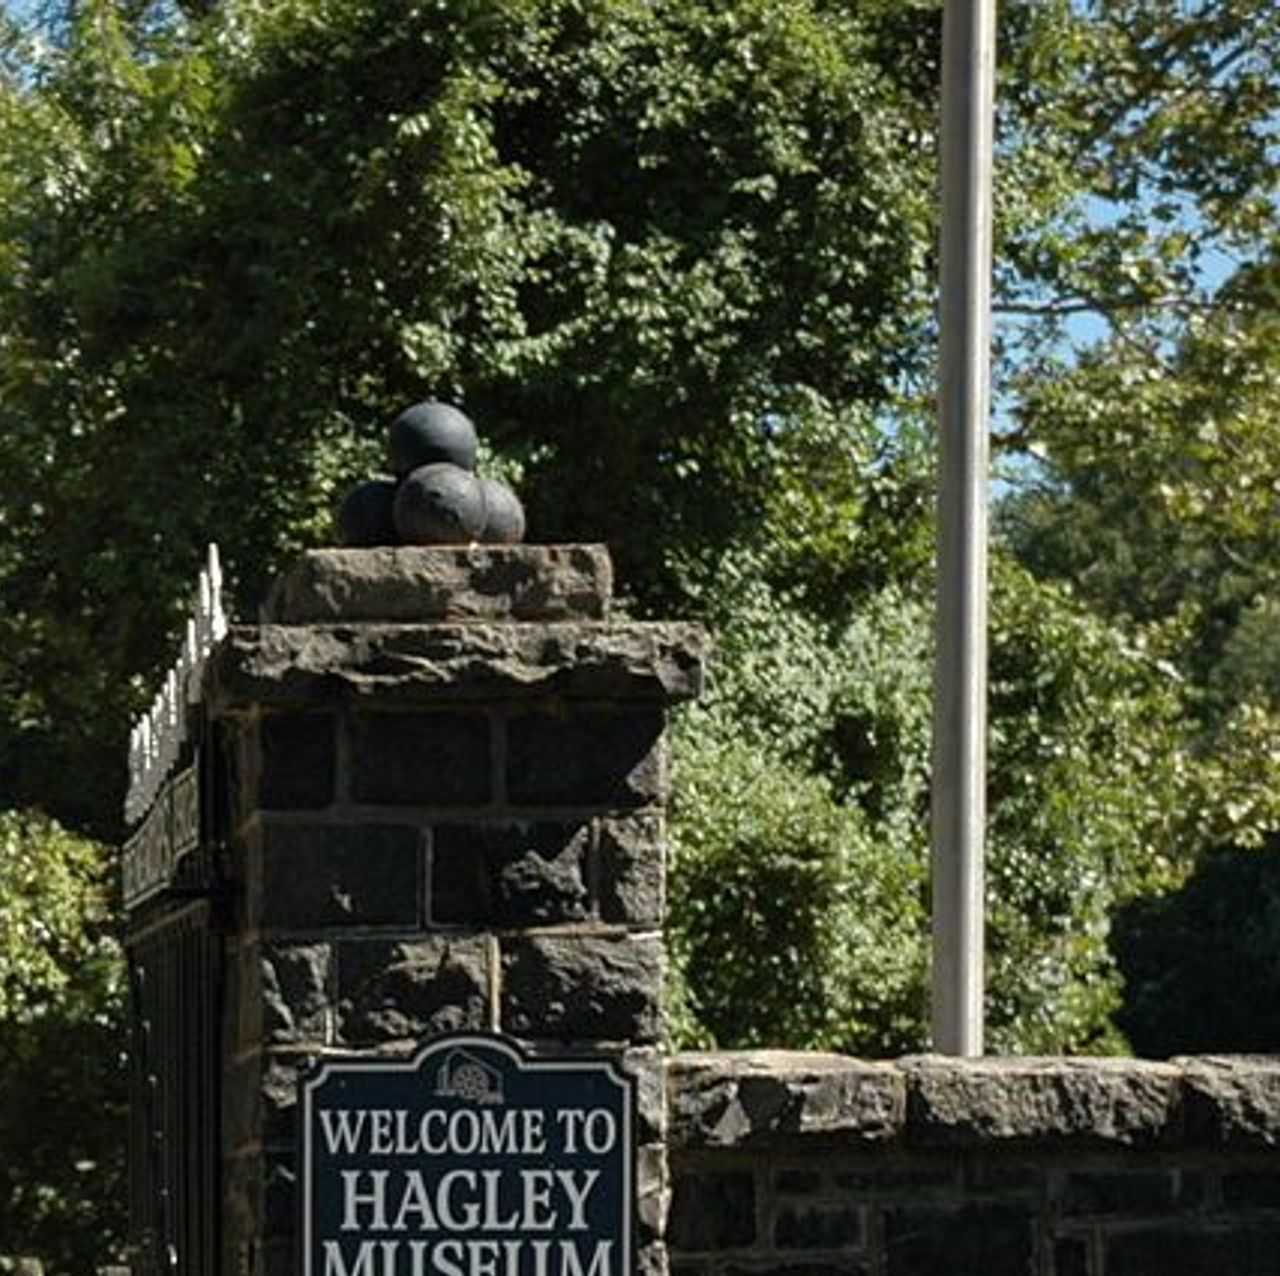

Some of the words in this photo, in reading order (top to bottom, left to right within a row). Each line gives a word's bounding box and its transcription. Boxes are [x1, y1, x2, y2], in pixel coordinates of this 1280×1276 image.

[320, 1110, 545, 1154] WELCOME
[557, 1109, 615, 1153] TO
[341, 1170, 599, 1230] HAGLEY
